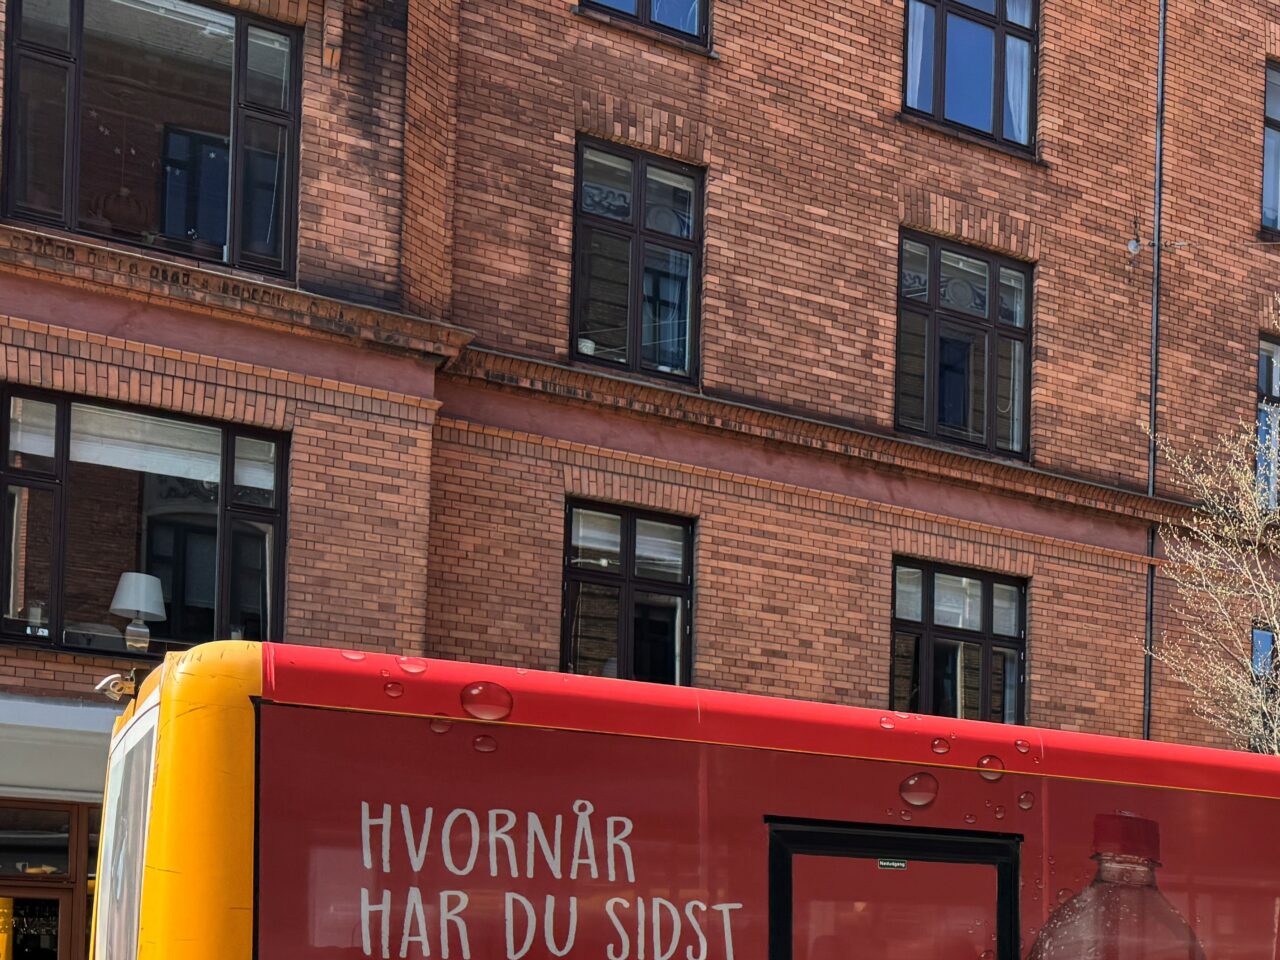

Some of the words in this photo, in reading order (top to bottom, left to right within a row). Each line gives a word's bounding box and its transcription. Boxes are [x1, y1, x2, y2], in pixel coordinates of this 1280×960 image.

[360, 799, 636, 882] HVORNÅR
[360, 887, 471, 960] HAR
[505, 893, 578, 960] DU
